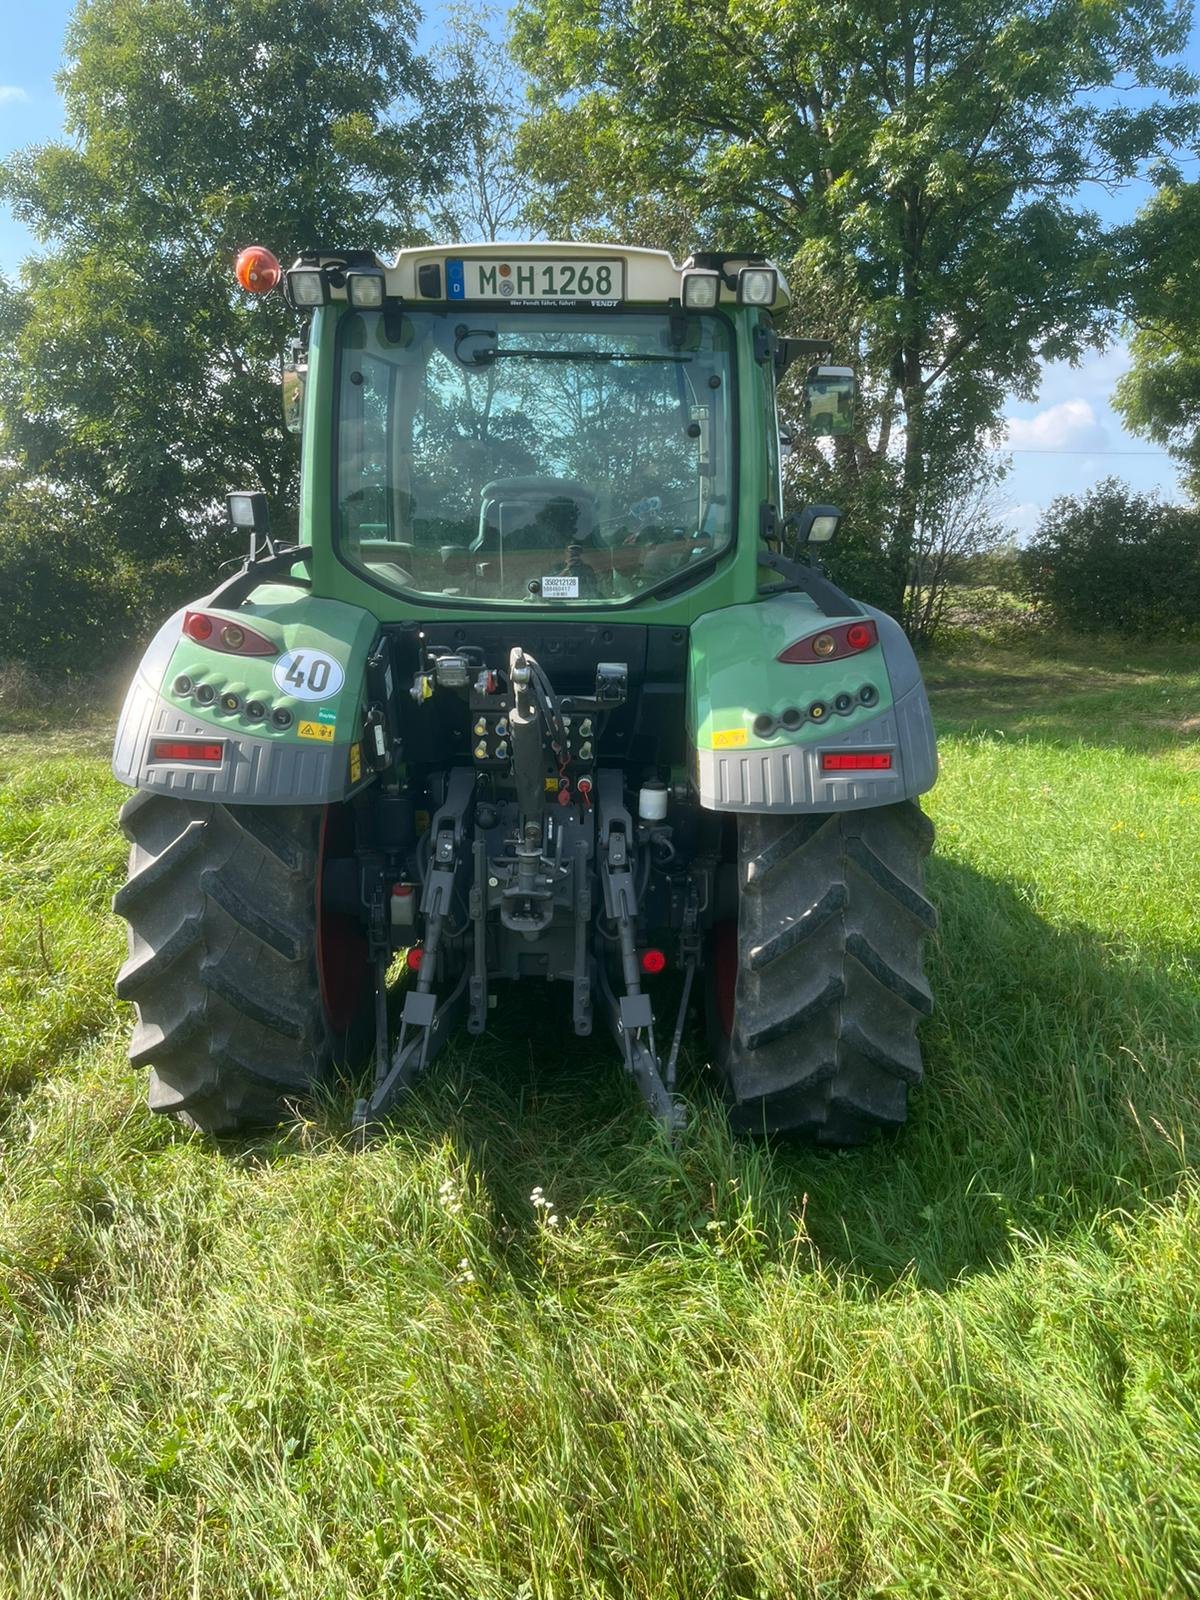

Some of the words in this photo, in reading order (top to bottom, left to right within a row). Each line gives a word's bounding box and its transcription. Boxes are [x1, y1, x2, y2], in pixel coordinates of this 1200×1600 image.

[453, 284, 460, 292] D
[479, 265, 497, 295] M
[284, 655, 332, 693] 40
